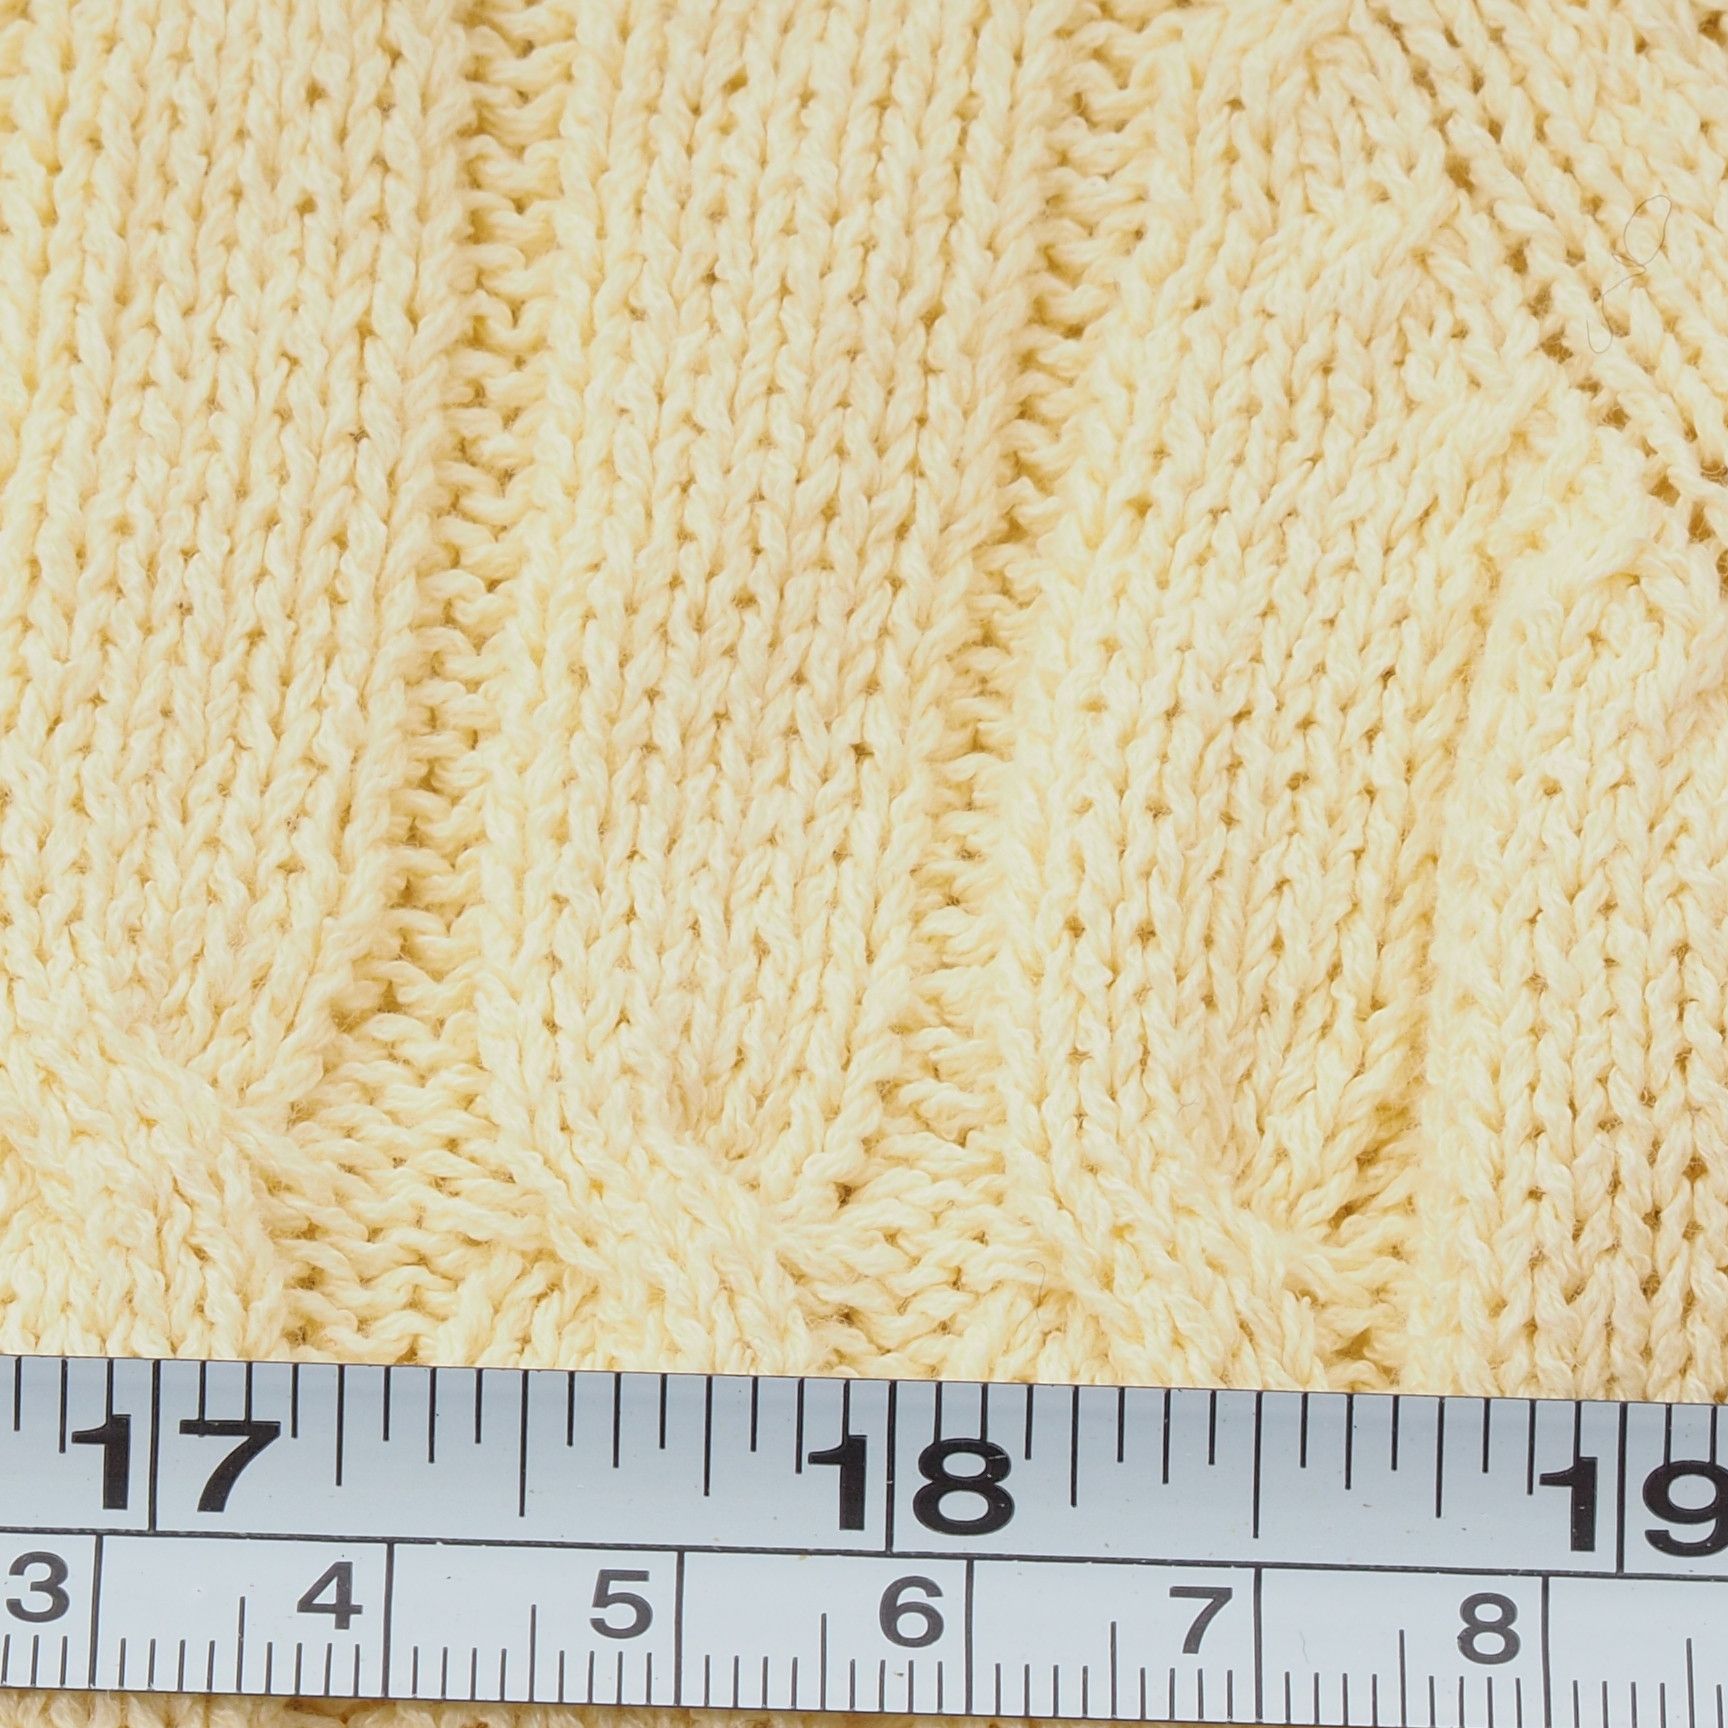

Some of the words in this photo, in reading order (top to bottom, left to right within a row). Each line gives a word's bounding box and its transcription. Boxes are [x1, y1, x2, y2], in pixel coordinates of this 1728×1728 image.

[71, 1413, 281, 1513] 17
[808, 1434, 1015, 1535] 18
[5, 1550, 70, 1623] 3
[297, 1561, 363, 1630] 4
[589, 1569, 653, 1639] 5
[878, 1576, 944, 1648] 6
[1169, 1586, 1233, 1655] 7
[1457, 1591, 1522, 1665] 8
